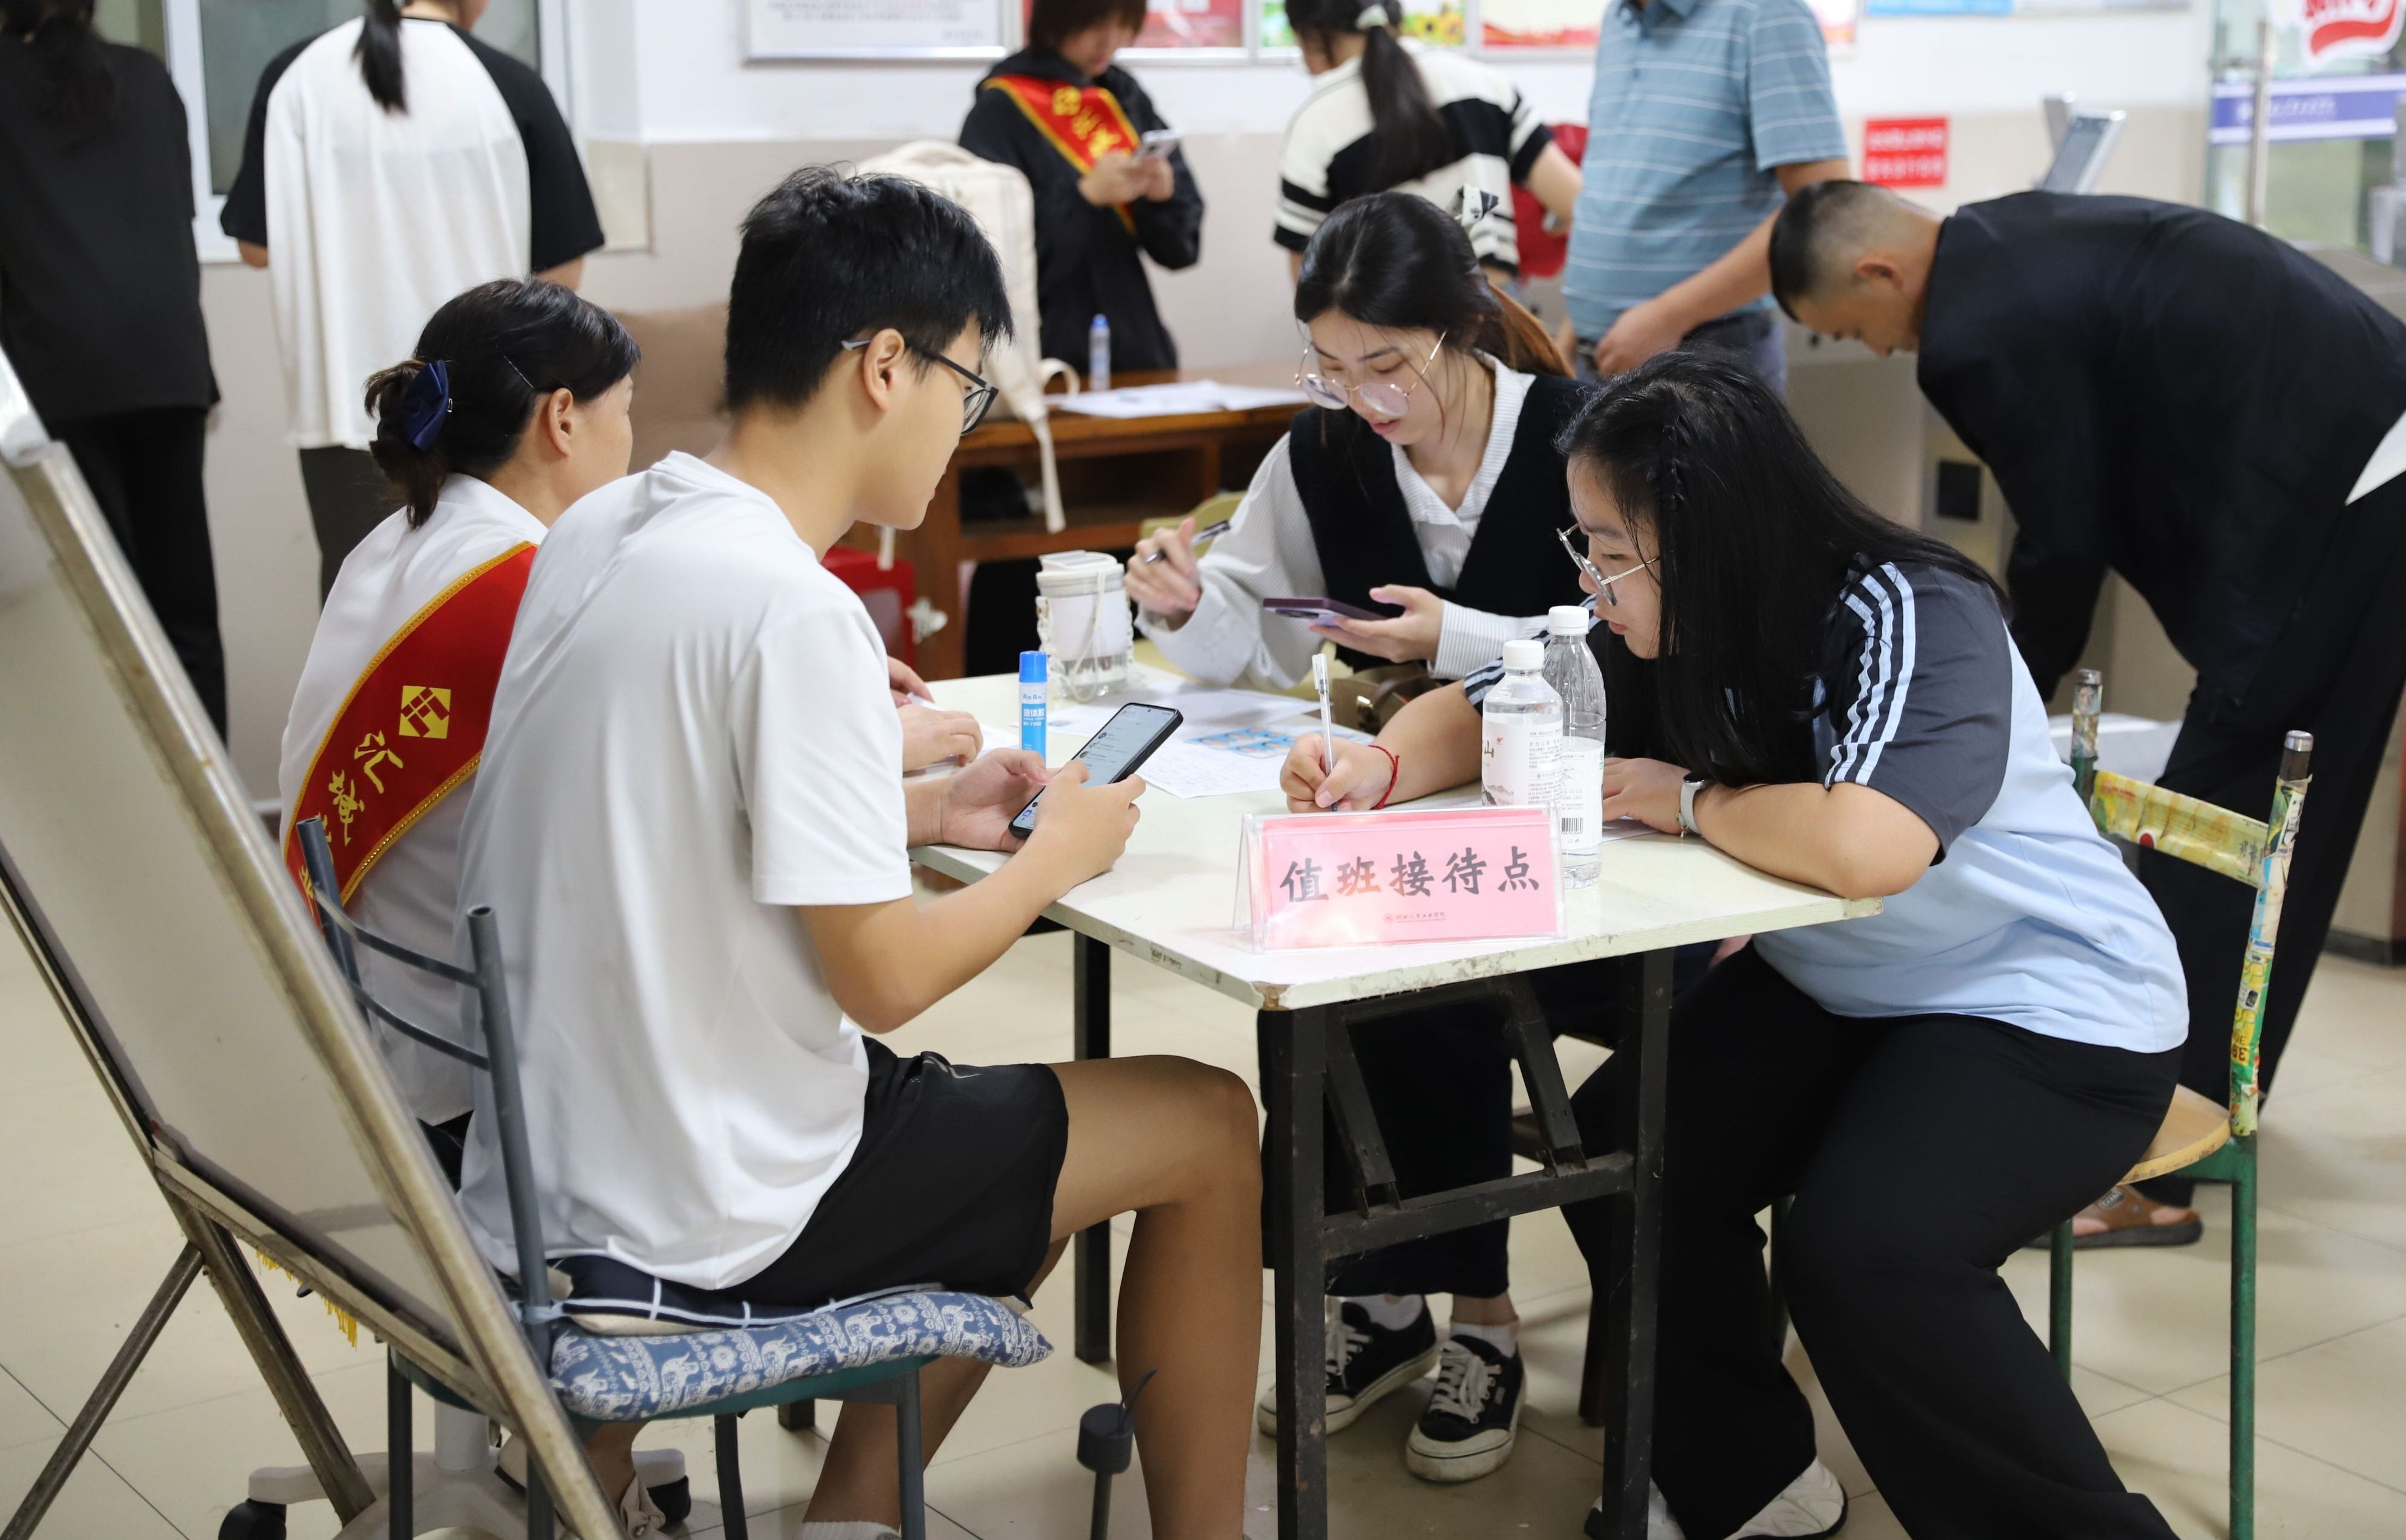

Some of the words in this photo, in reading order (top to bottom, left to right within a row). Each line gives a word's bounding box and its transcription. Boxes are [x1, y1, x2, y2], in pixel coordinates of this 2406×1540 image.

[1280, 845, 1539, 903] 值班接待点
